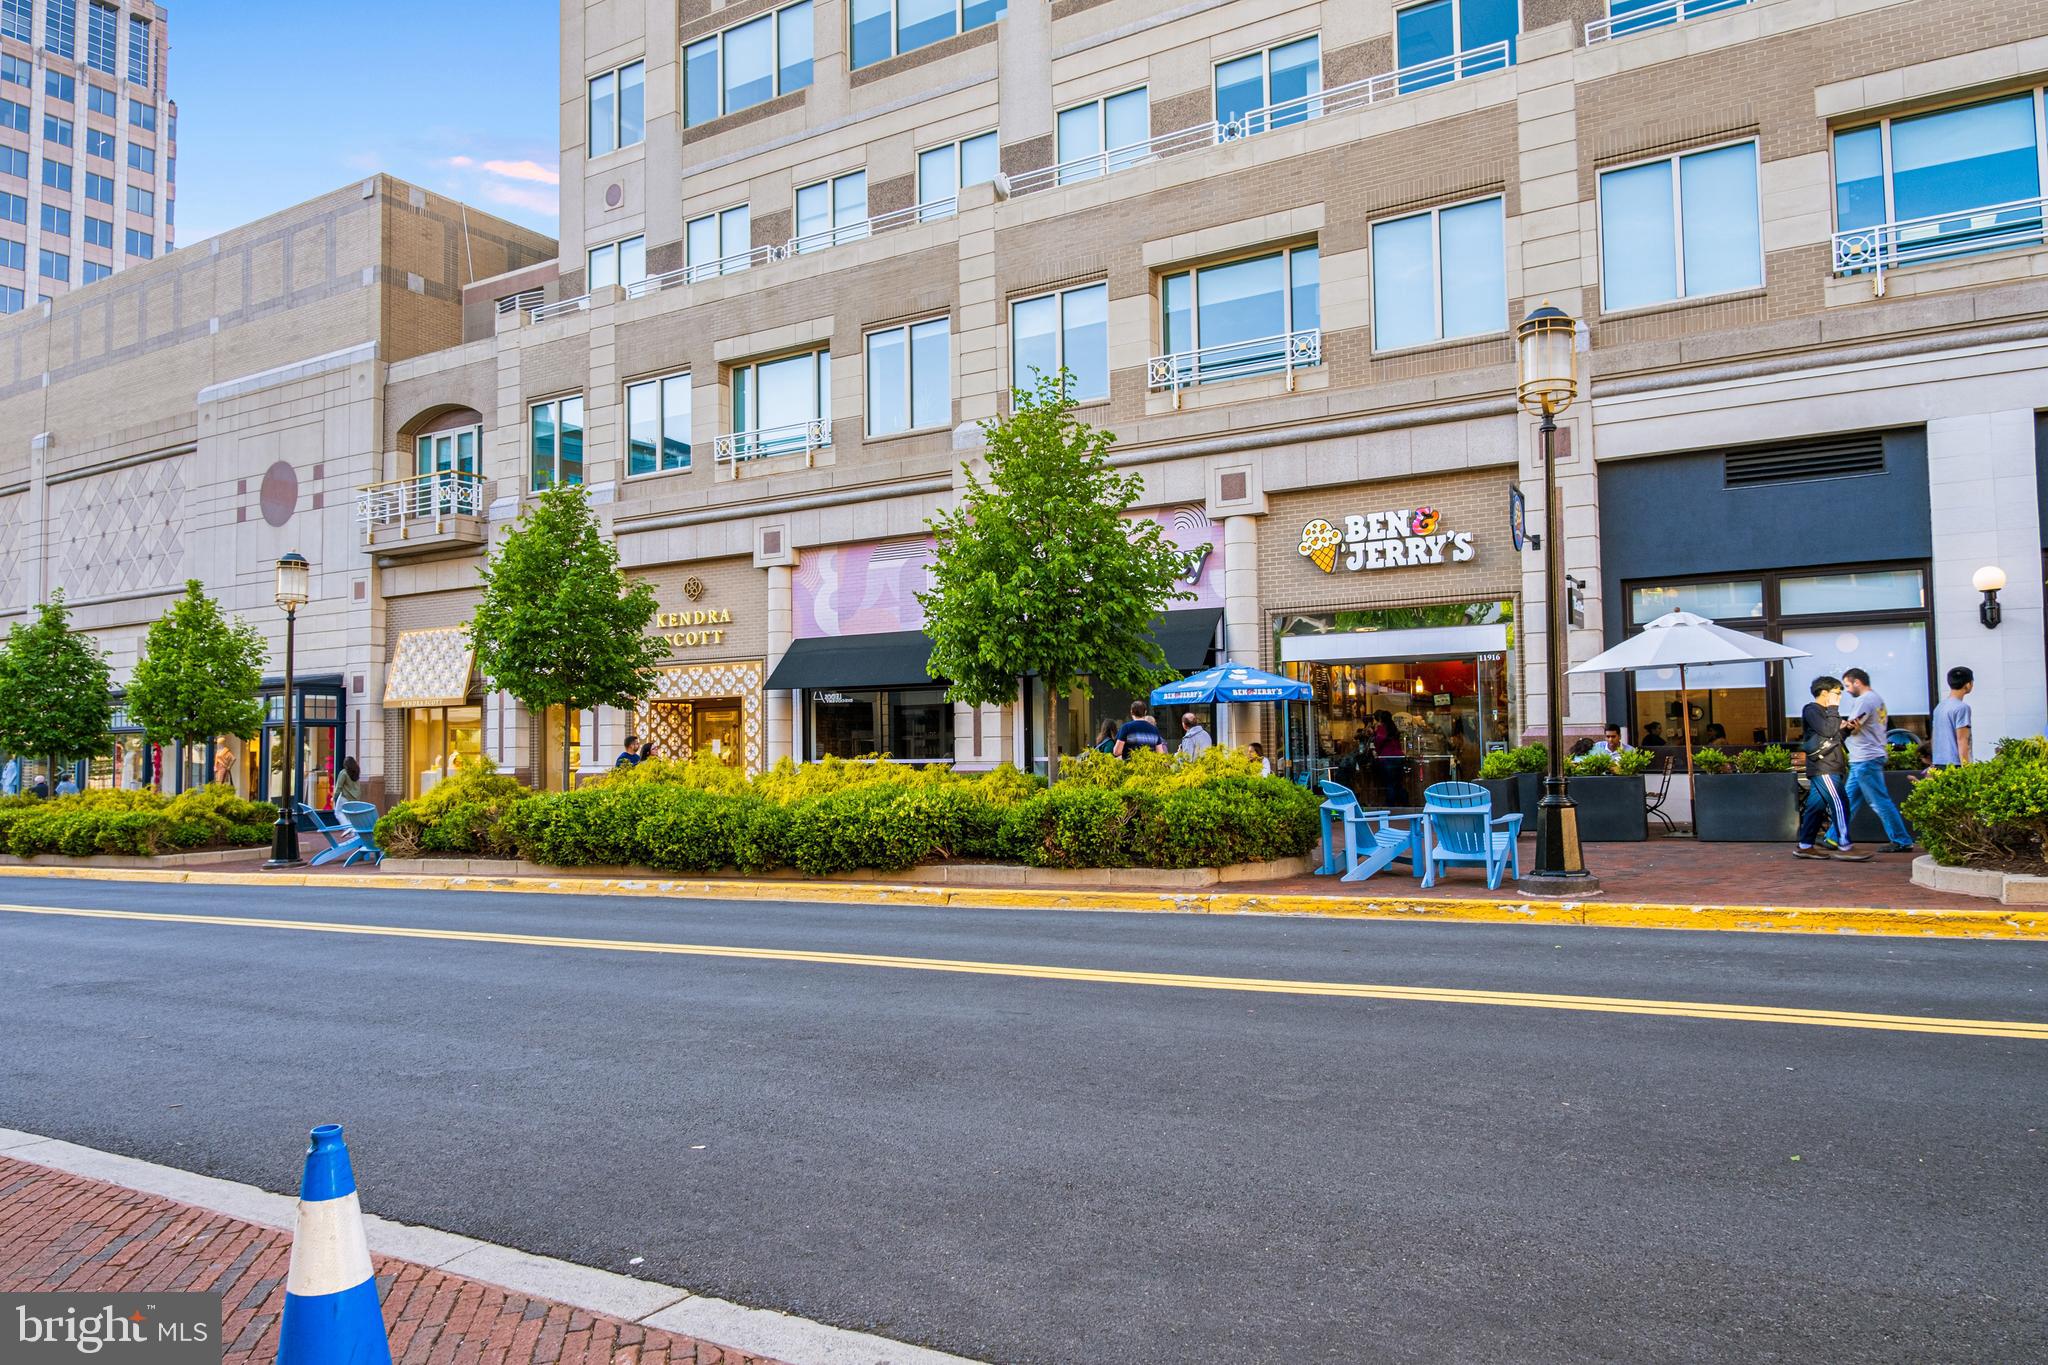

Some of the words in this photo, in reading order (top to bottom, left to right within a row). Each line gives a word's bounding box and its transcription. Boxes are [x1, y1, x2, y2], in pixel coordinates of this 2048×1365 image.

[1344, 509, 1411, 543] BEN
[1411, 506, 1442, 537] &
[1345, 530, 1476, 571] JERRY'S
[655, 607, 732, 628] KENDRA
[664, 629, 724, 647] SCOTT
[1479, 653, 1501, 662] 11916
